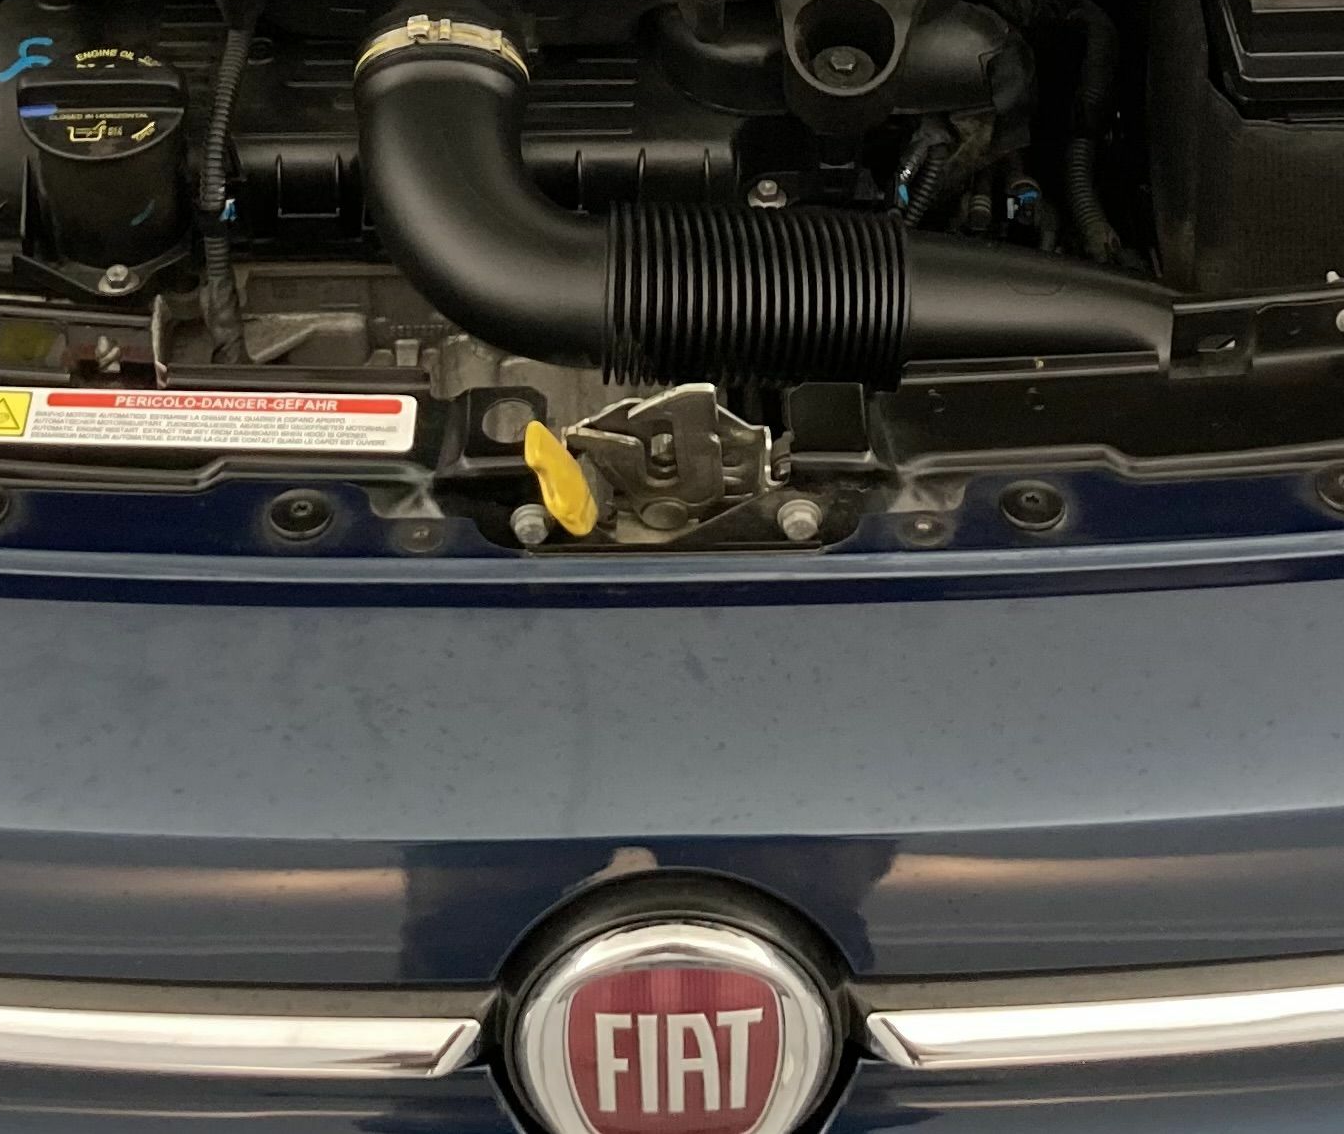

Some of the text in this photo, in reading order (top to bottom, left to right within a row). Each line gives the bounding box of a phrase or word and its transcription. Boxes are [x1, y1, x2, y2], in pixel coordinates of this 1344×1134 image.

[75, 48, 135, 62] ENGINE OIL
[114, 395, 339, 413] PERICOLO-DANGER-GEFAHR
[594, 1007, 764, 1114] FIAT
